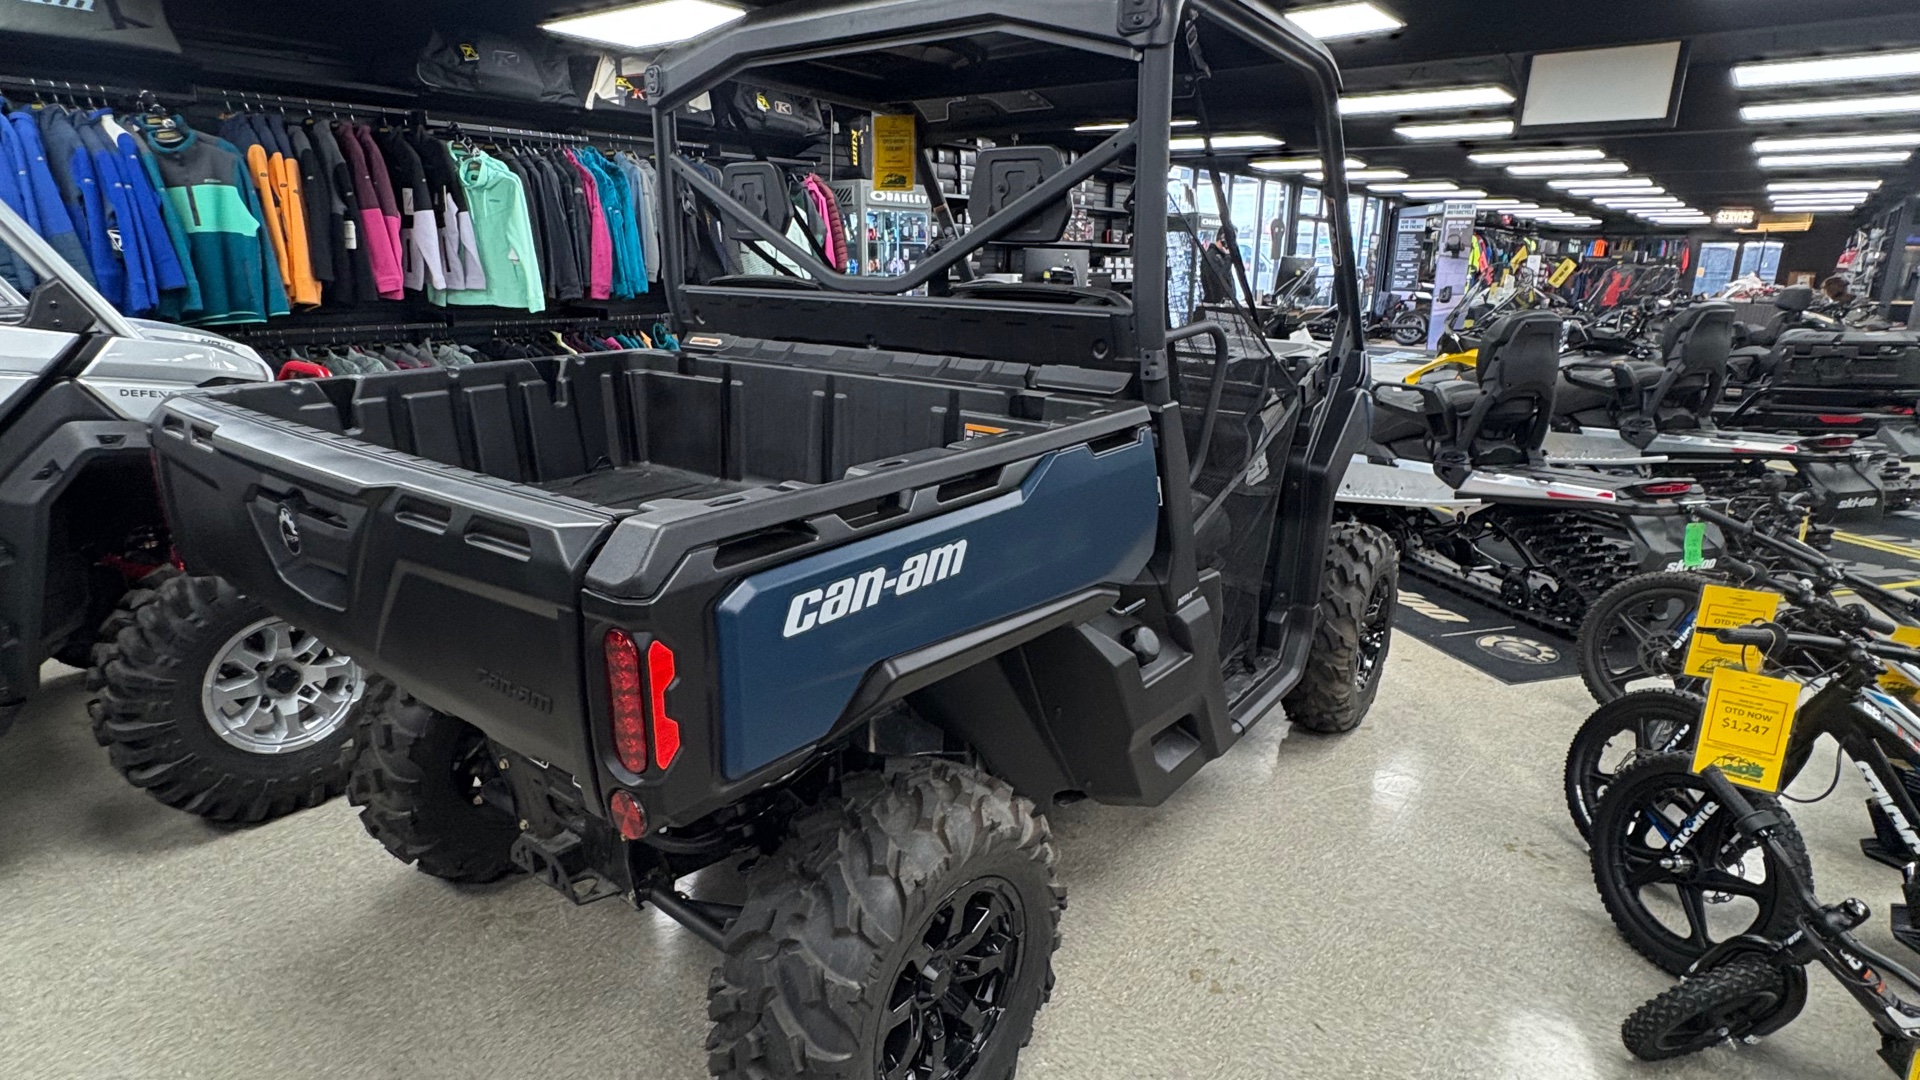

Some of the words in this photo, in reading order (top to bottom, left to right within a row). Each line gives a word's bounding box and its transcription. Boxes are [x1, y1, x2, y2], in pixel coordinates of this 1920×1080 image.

[886, 191, 928, 204] OAKLEY
[1717, 209, 1755, 224] SERVICE
[1837, 496, 1878, 509] ski-doo
[782, 538, 968, 639] can-am
[1724, 706, 1746, 718] OTD
[1746, 710, 1773, 722] NOW
[1721, 716, 1770, 736] $1,247
